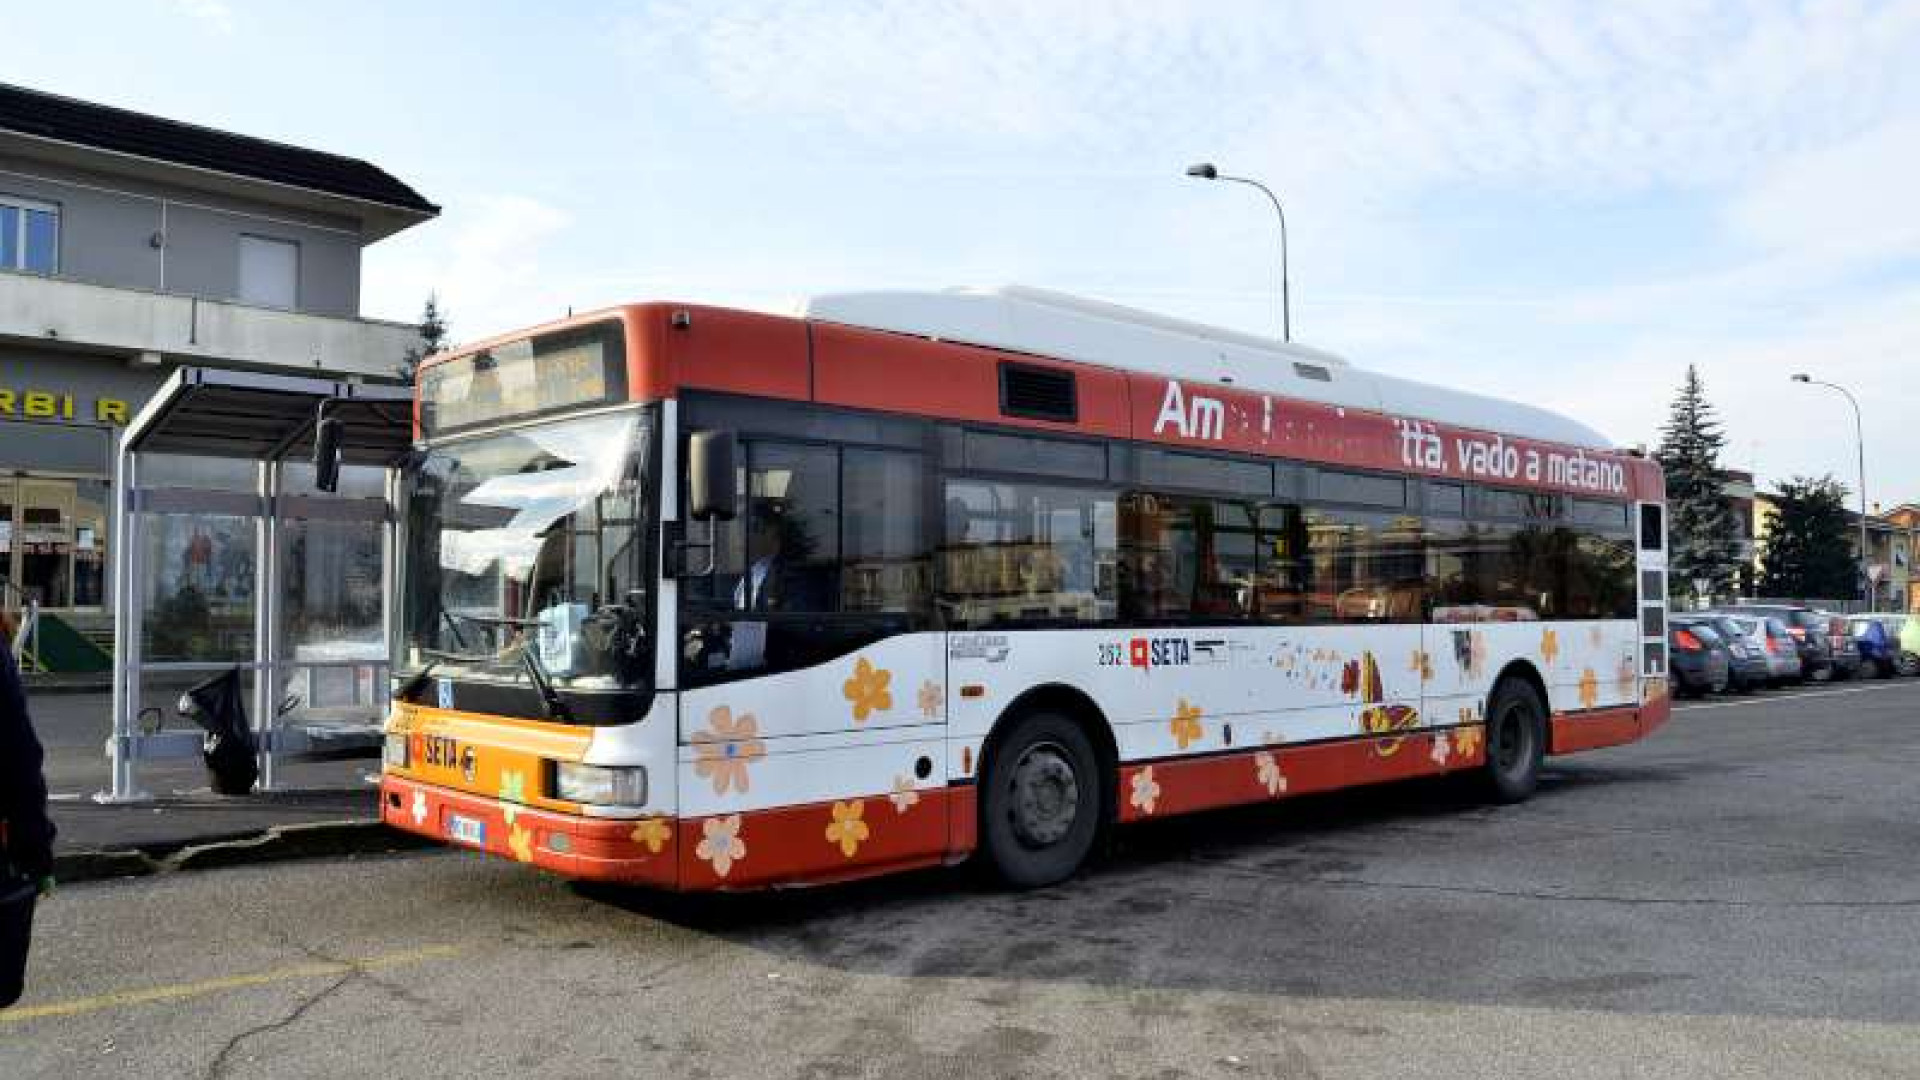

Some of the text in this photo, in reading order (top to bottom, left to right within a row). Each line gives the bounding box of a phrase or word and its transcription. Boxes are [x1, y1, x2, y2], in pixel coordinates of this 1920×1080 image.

[1154, 380, 1248, 440] Am
[1456, 436, 1519, 478] vado
[1526, 450, 1540, 481] a
[1151, 638, 1189, 665] SETA
[425, 734, 457, 768] SETA
